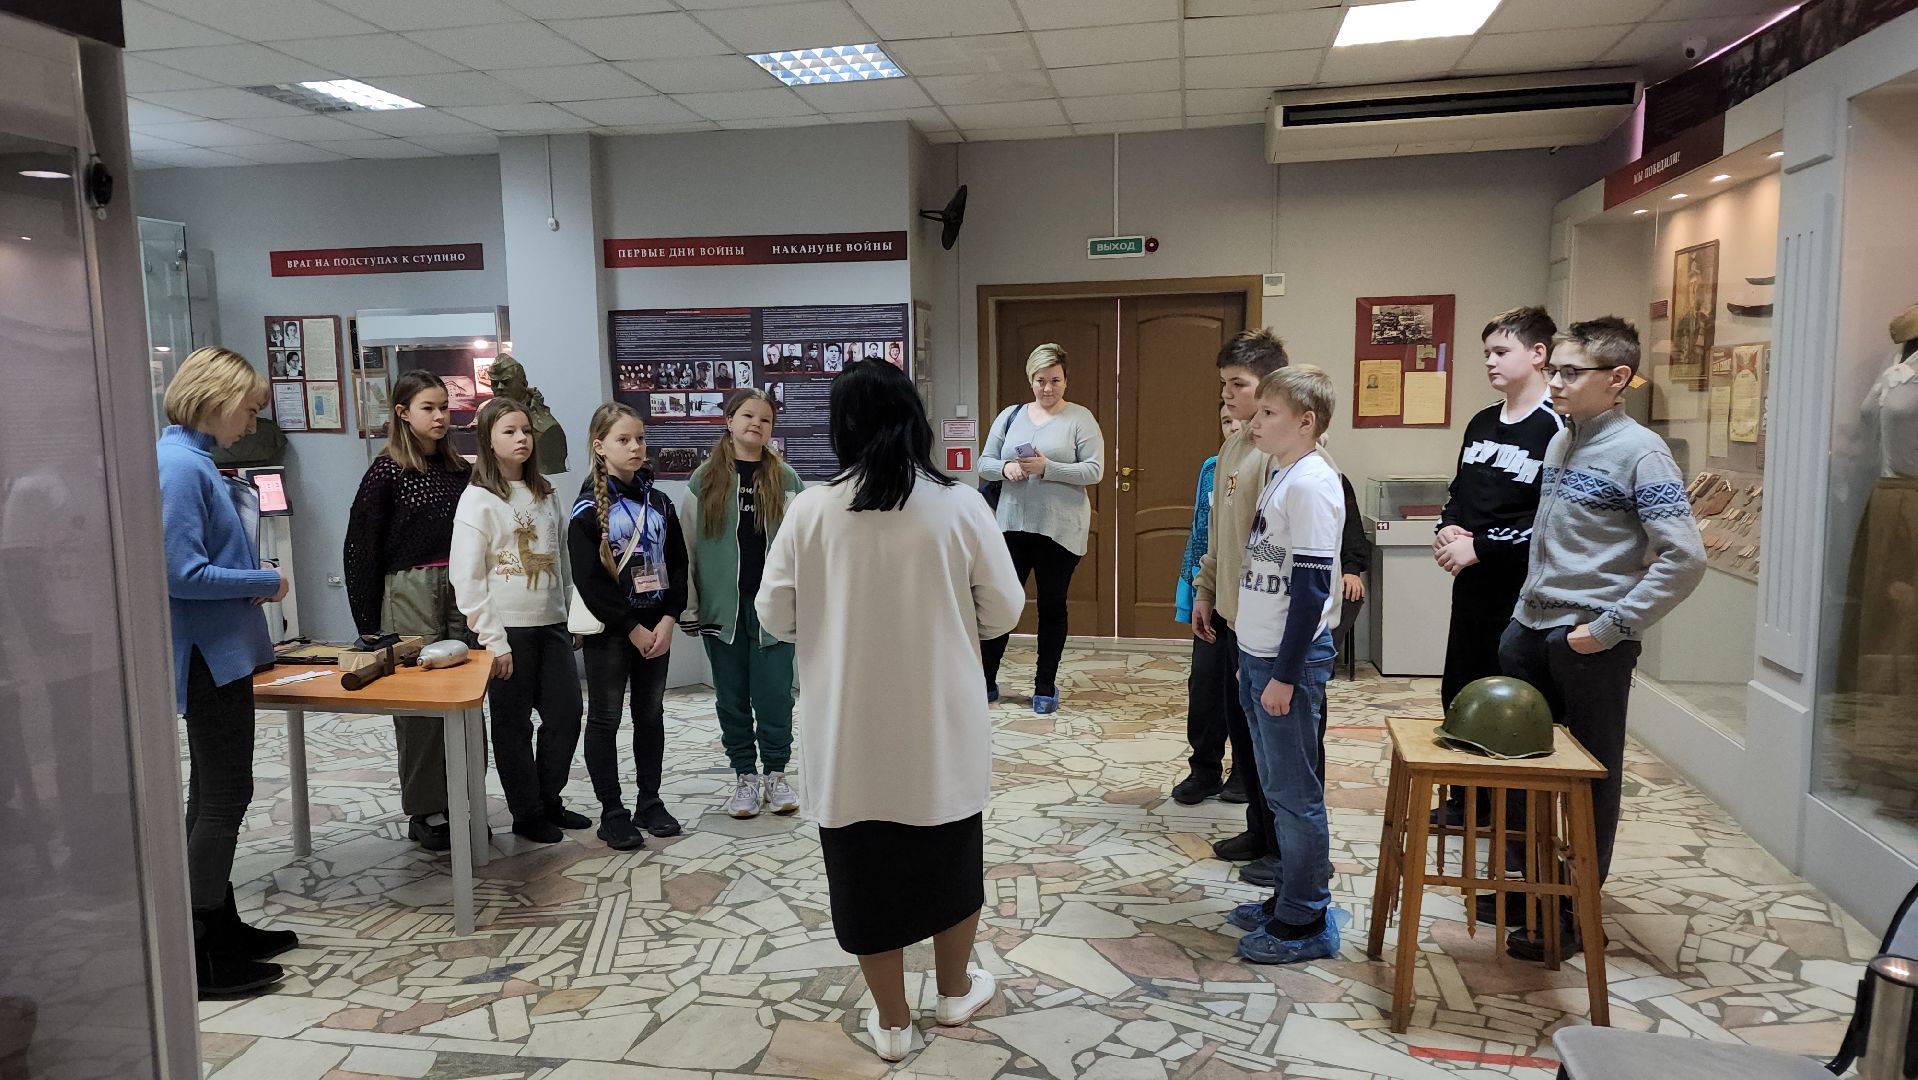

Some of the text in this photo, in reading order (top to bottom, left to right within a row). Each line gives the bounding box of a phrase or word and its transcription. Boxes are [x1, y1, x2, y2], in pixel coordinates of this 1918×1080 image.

[618, 245, 745, 258] ПЕРВЫЕ ДНИ ВОЙНЫ
[771, 240, 893, 255] НАКАНУНЕ ВОЙНЫ
[1096, 241, 1136, 251] ВЫХОД
[287, 253, 466, 268] ВРАГ НА ПОДСТУПАХ К СТУПИНО
[1378, 522, 1388, 530] 11
